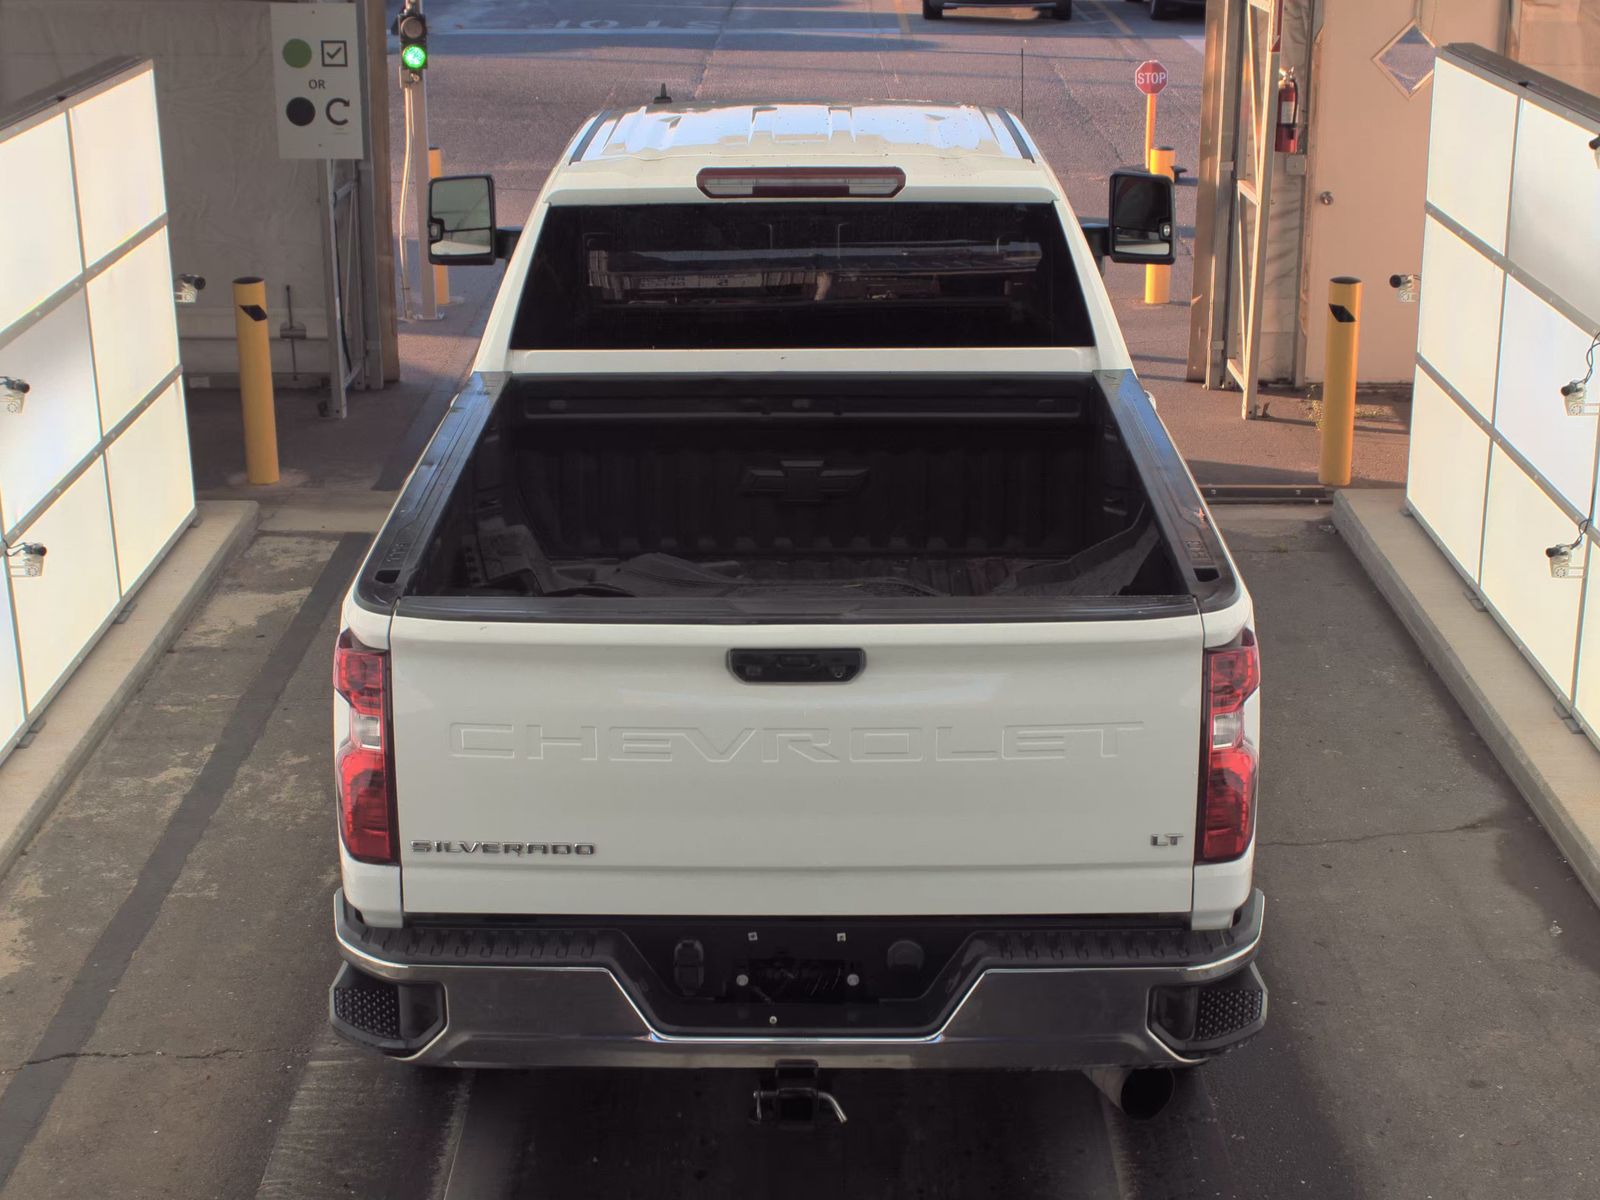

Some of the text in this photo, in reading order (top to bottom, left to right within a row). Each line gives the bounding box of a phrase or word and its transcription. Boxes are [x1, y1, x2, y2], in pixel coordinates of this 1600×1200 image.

[308, 79, 327, 90] OR
[1137, 72, 1166, 85] STOP
[449, 721, 1145, 763] CHEVROLET
[1150, 833, 1184, 847] LT
[411, 840, 595, 856] SILVERADO
